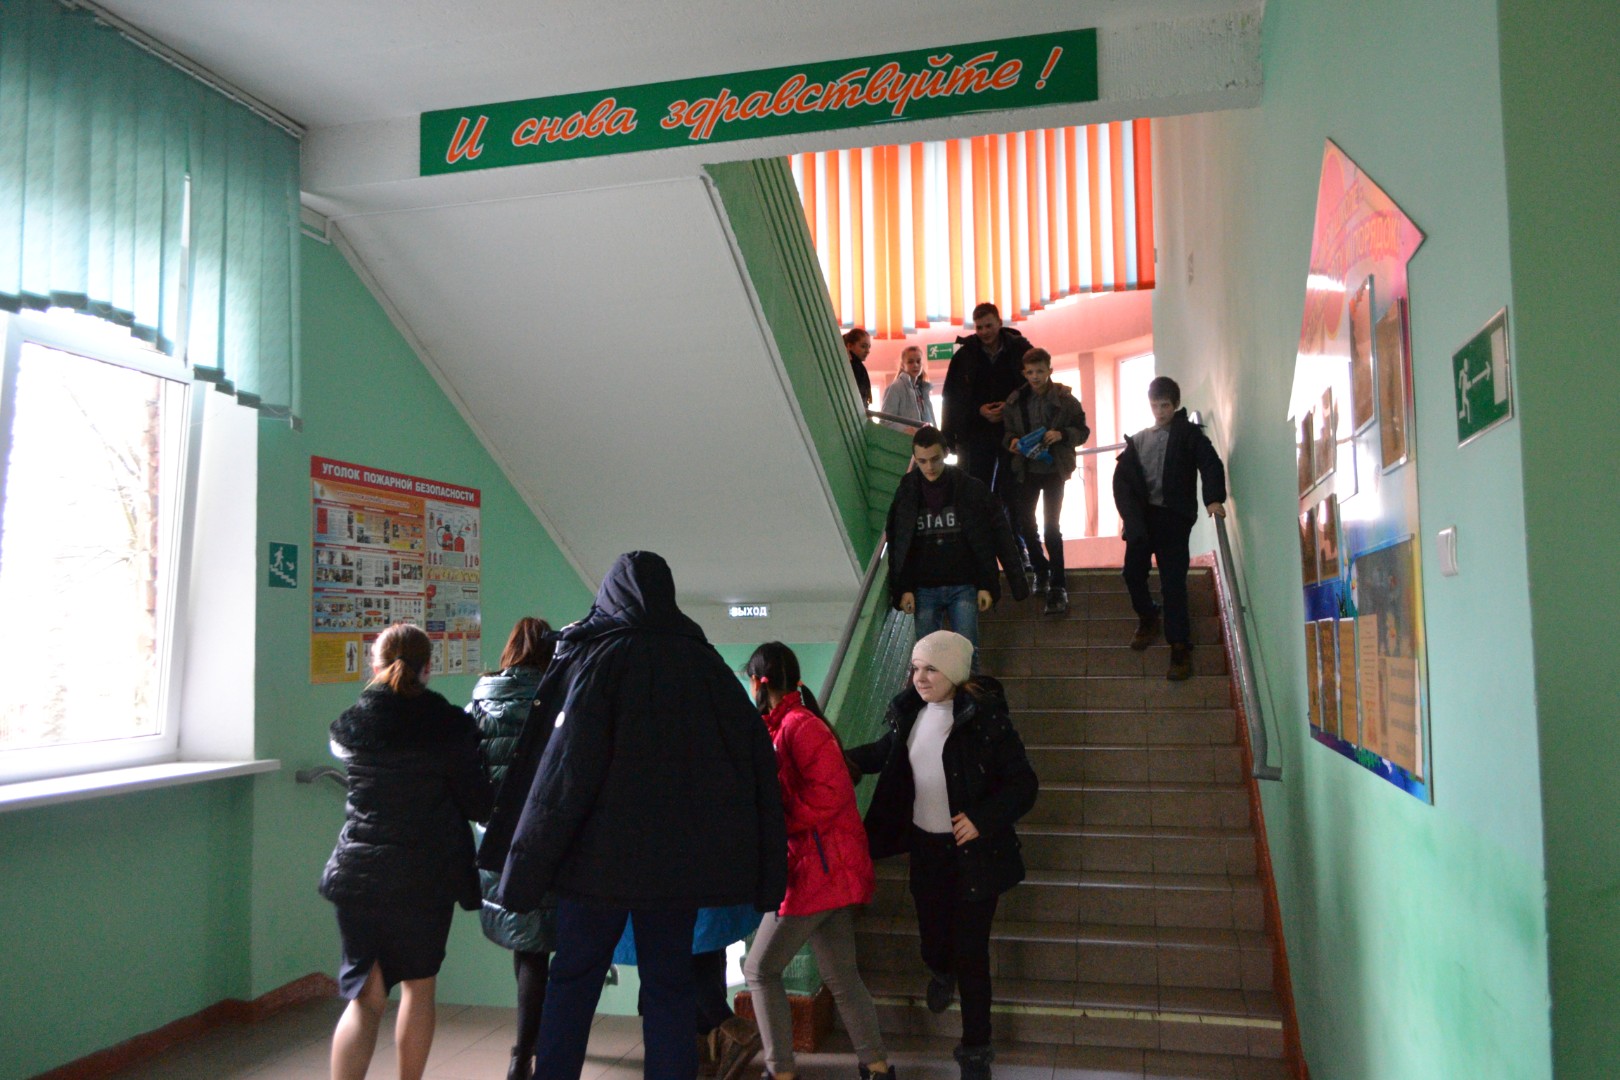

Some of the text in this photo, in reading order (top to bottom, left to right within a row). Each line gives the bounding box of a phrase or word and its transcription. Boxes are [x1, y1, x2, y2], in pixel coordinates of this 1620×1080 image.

[446, 46, 1063, 164] И снова здравствуйте !
[322, 462, 360, 481] УГОЛОК
[364, 471, 413, 491] ПОЖАРНОЙ
[415, 481, 475, 502] БЕЗОПАСНОСТИ
